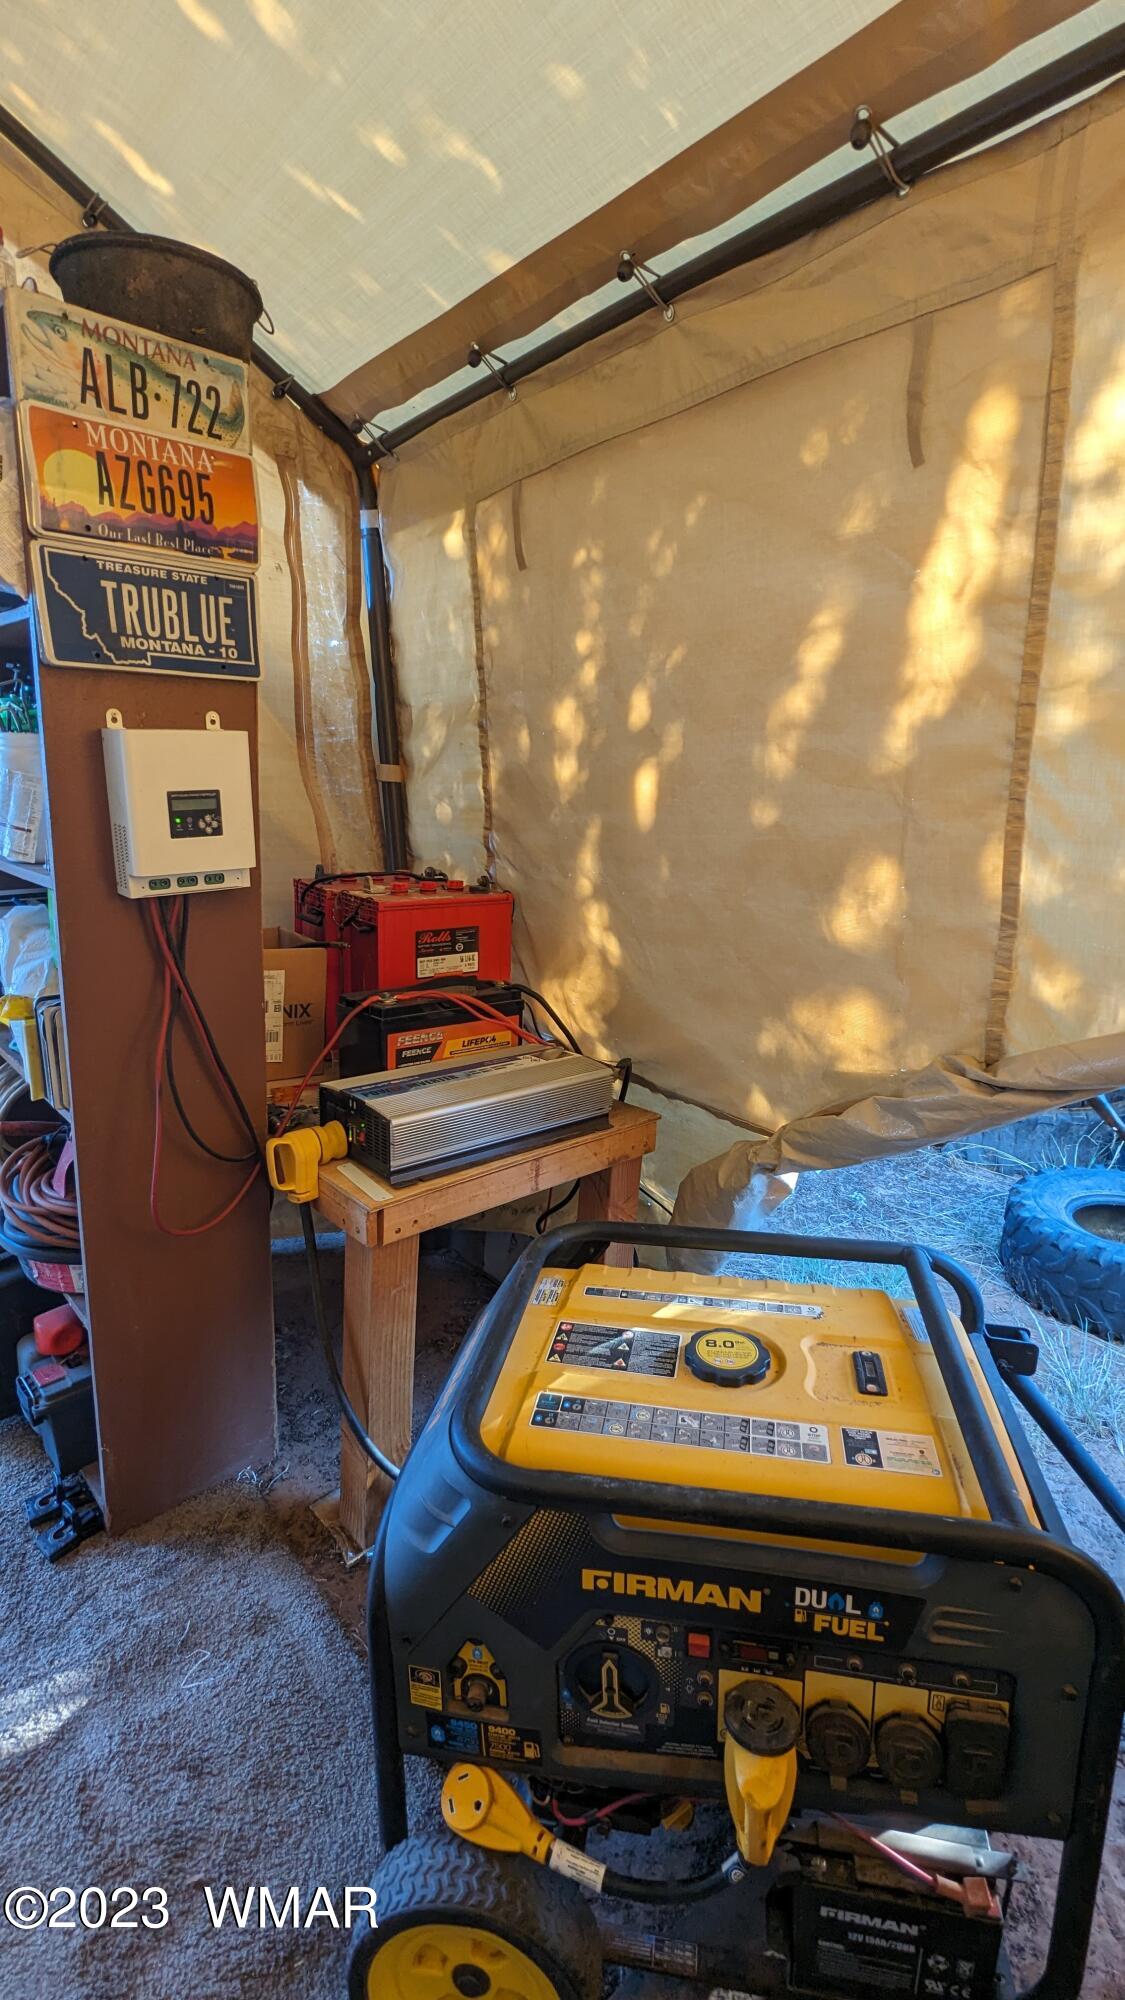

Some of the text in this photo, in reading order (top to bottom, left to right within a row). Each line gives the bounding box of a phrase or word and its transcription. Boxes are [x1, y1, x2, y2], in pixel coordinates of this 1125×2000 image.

[81, 317, 197, 371] MONTANA
[84, 421, 215, 473] MONTANA
[95, 451, 214, 525] AZG695
[98, 524, 214, 555] Our Last Best Place
[96, 560, 208, 585] TREASURE STATE
[100, 579, 236, 647] TRUBLUE
[120, 636, 206, 656] MONTANA
[221, 647, 238, 659] 10
[705, 1339, 735, 1349] 8.0
[581, 1568, 762, 1614] FIRMAN
[813, 1613, 885, 1642] FUEL
[820, 1906, 918, 1936] FIRMAN
